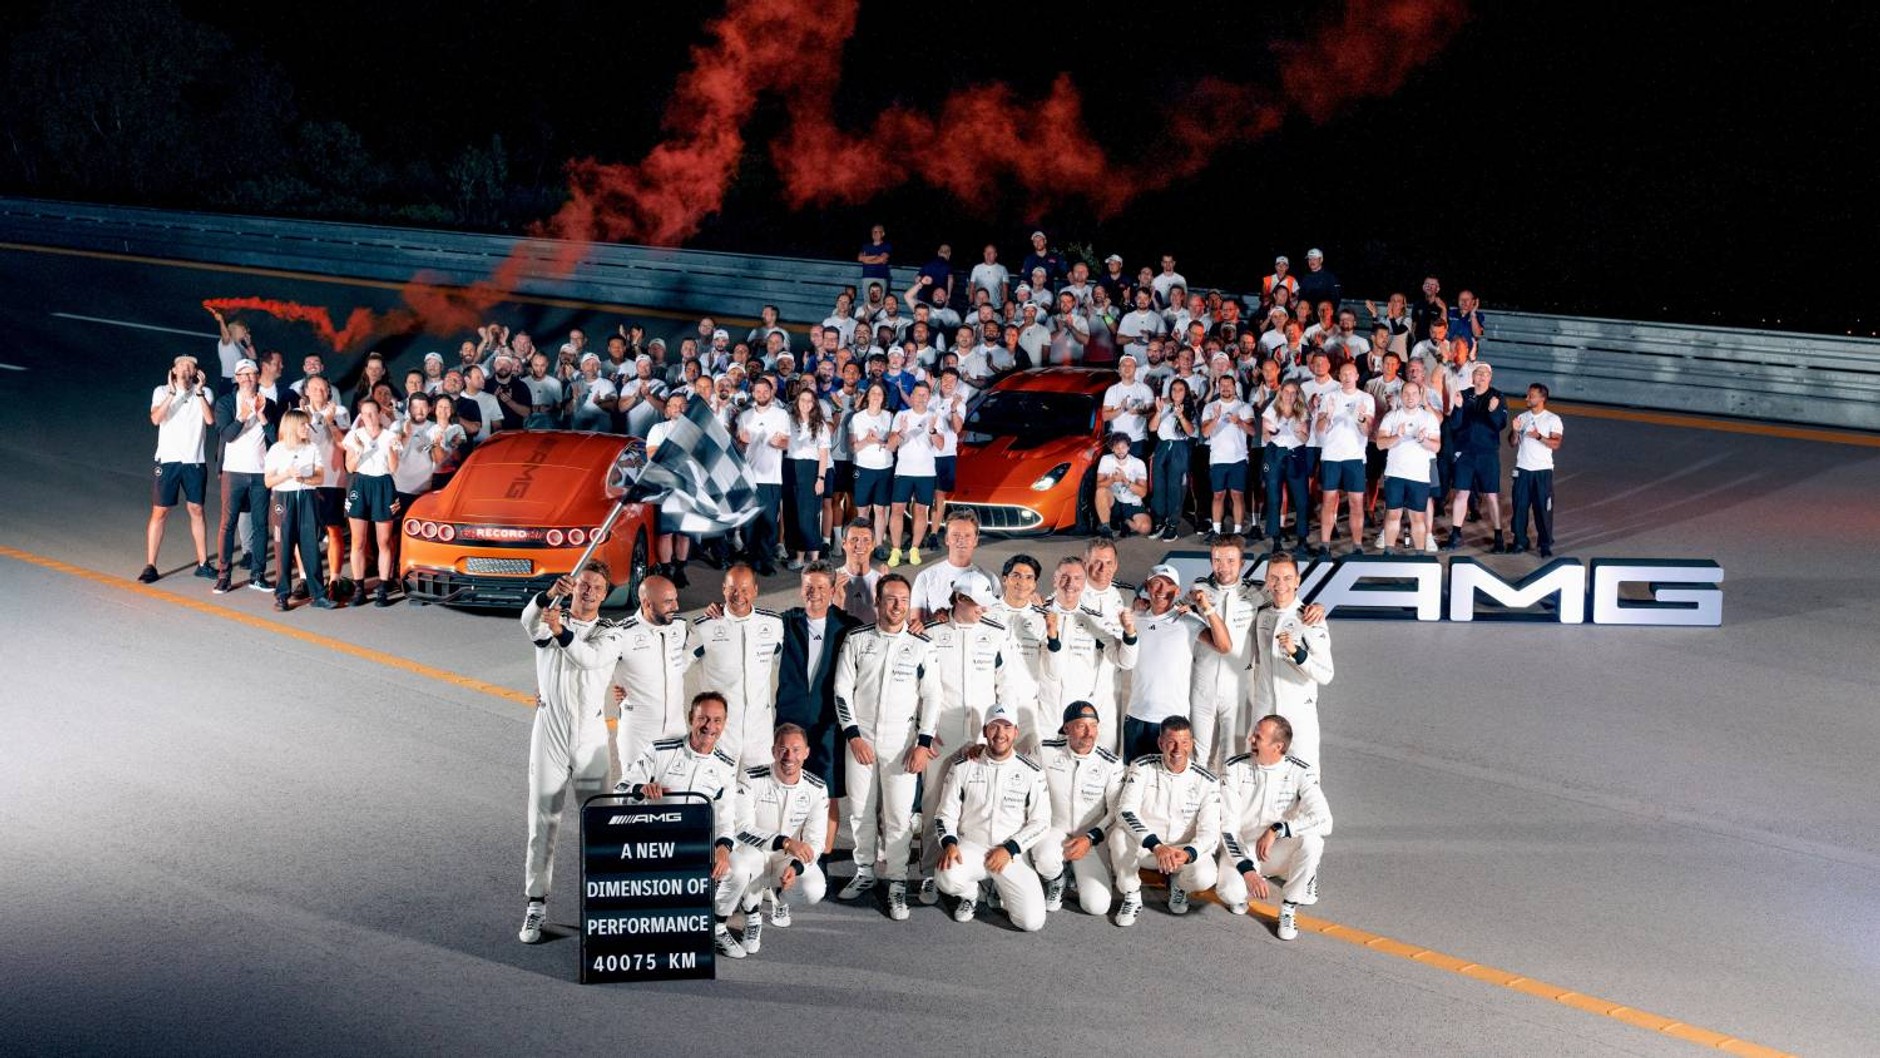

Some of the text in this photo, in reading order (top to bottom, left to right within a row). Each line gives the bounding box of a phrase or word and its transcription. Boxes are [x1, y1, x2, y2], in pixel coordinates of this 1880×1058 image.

[475, 528, 527, 538] RECORD
[1306, 560, 1724, 626] AMG
[631, 812, 682, 823] AMG
[620, 842, 675, 860] A NEW
[587, 878, 709, 898] DIMENSION OF
[587, 915, 709, 936] PERFORMANCE
[593, 951, 696, 972] 40075 KM
